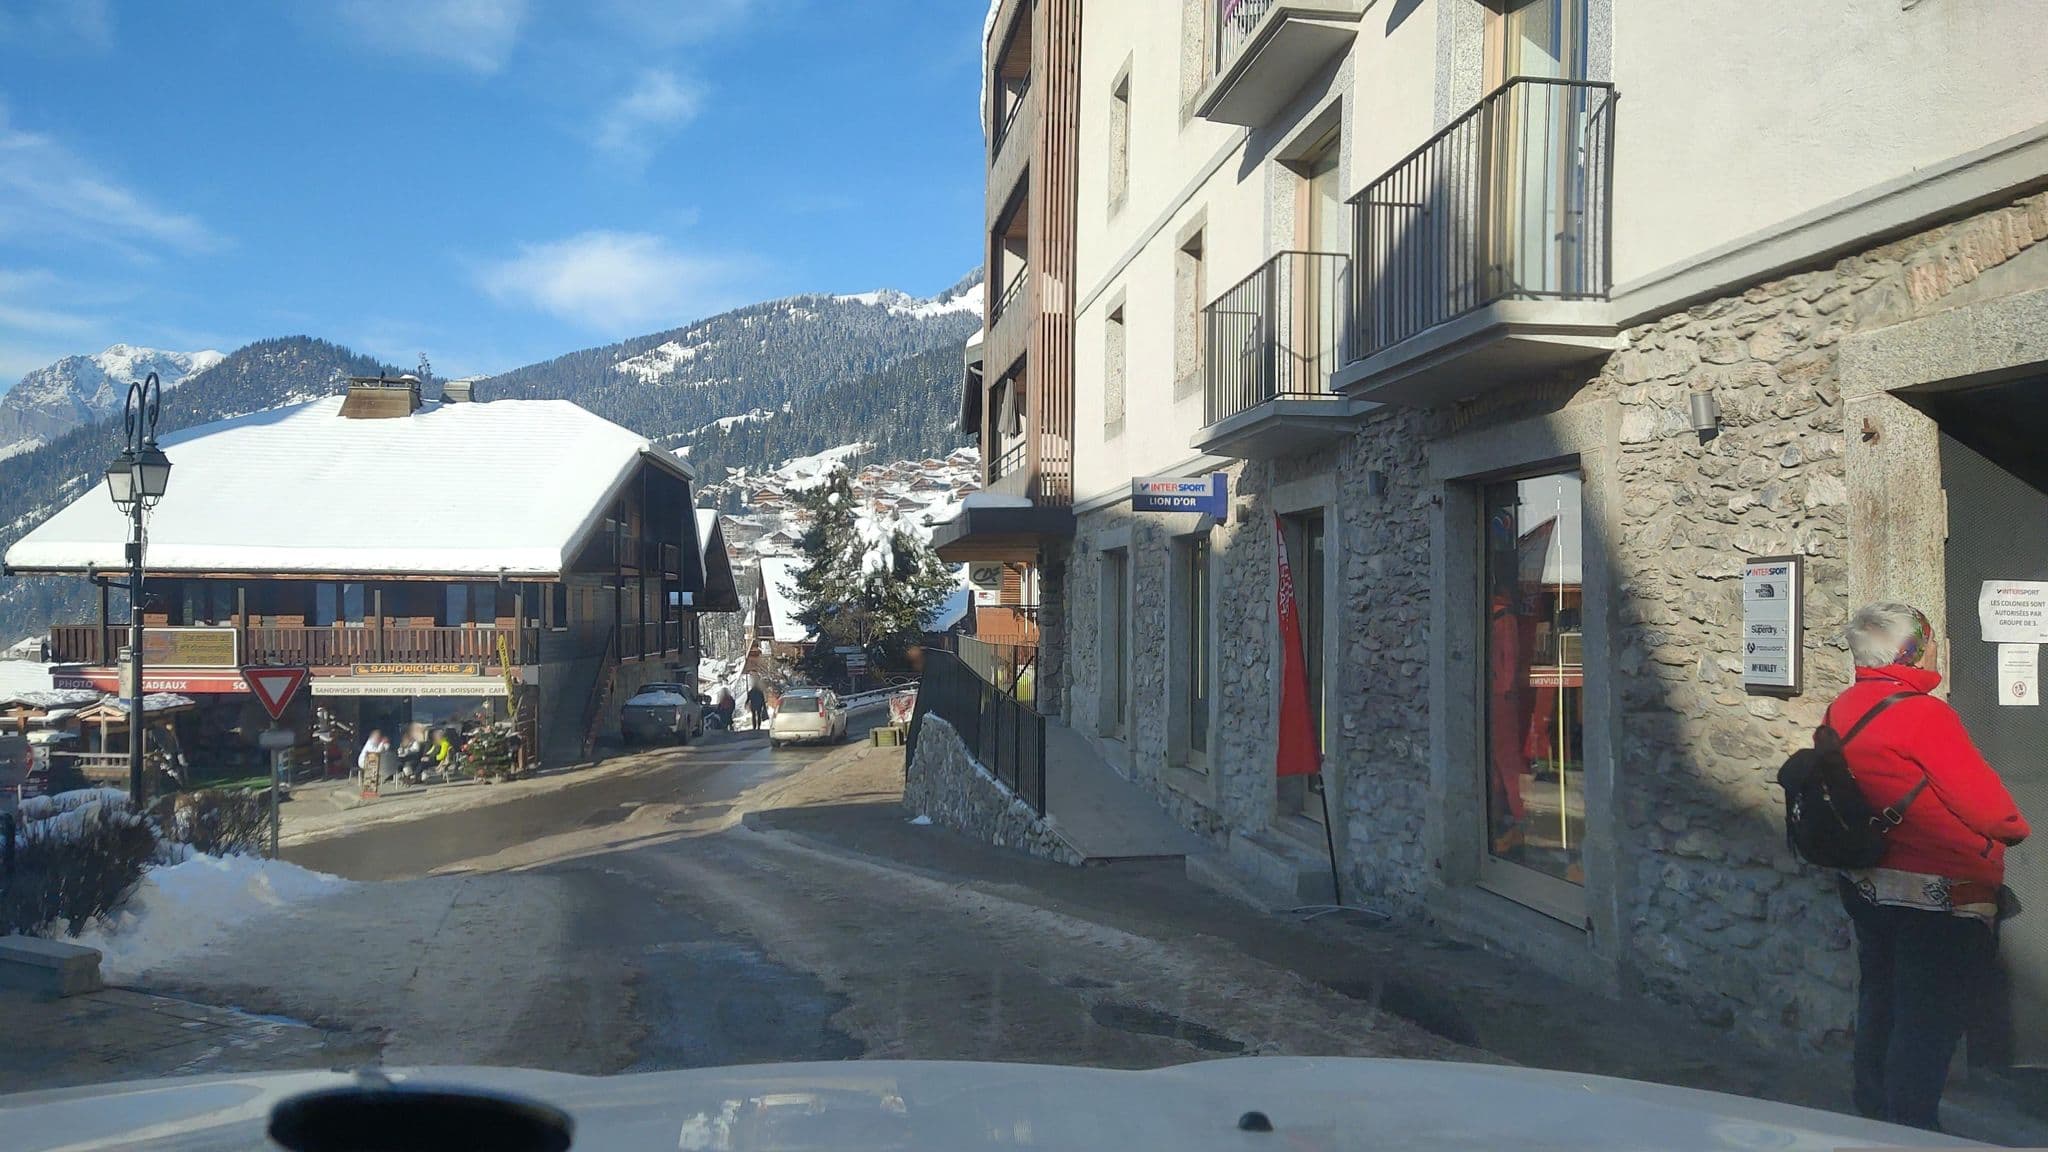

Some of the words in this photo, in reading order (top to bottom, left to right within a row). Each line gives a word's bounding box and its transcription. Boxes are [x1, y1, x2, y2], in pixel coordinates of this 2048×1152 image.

[1150, 482, 1206, 492] INTERSPORT
[1149, 497, 1171, 505] LION
[1173, 497, 1196, 506] D'OR
[1752, 567, 1787, 577] INTERSPORT
[370, 664, 461, 674] SANDWICHERIE
[58, 680, 93, 688] PHOTO
